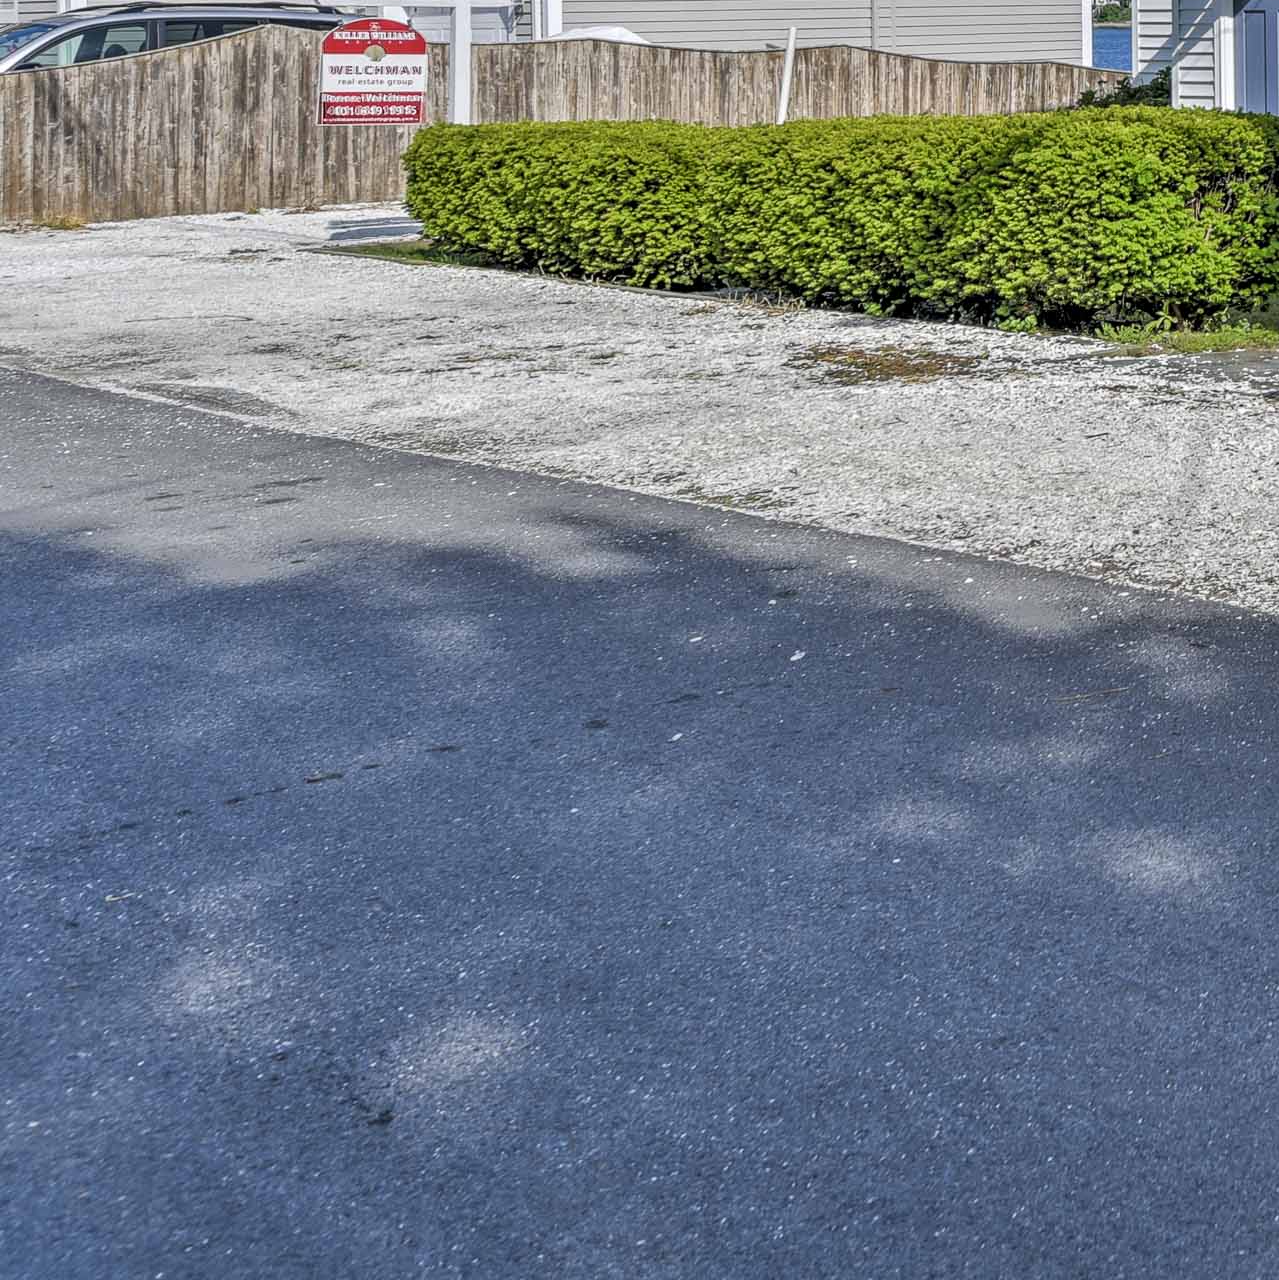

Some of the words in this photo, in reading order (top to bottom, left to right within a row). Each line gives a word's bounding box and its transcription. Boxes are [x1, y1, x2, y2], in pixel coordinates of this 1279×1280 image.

[333, 31, 370, 40] KELLER
[371, 31, 416, 40] WILLIAMS
[329, 65, 422, 75] WELCHMAN
[338, 77, 354, 86] real
[358, 78, 384, 86] estate
[387, 79, 414, 87] group
